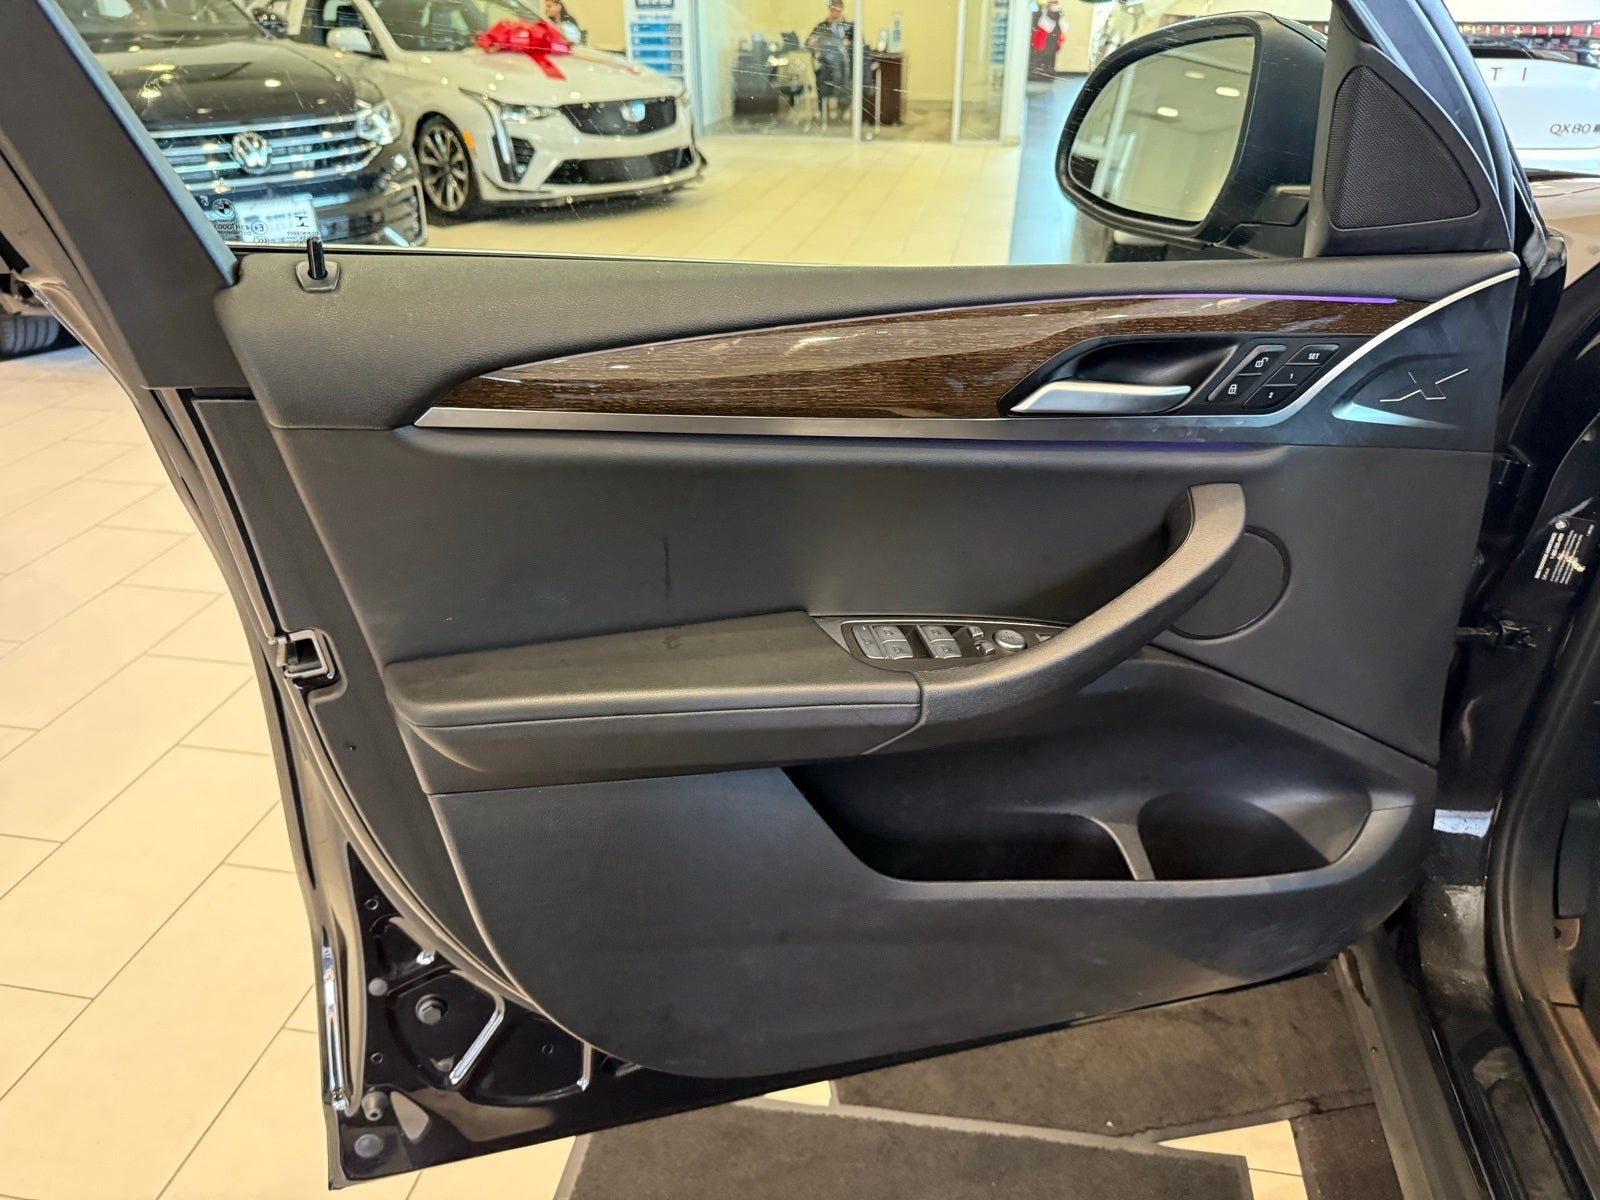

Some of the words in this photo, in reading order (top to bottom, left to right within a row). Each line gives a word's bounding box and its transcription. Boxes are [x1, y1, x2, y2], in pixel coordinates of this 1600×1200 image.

[1549, 123, 1592, 136] QX80
[1307, 352, 1320, 360] SET
[1267, 391, 1274, 399] 2
